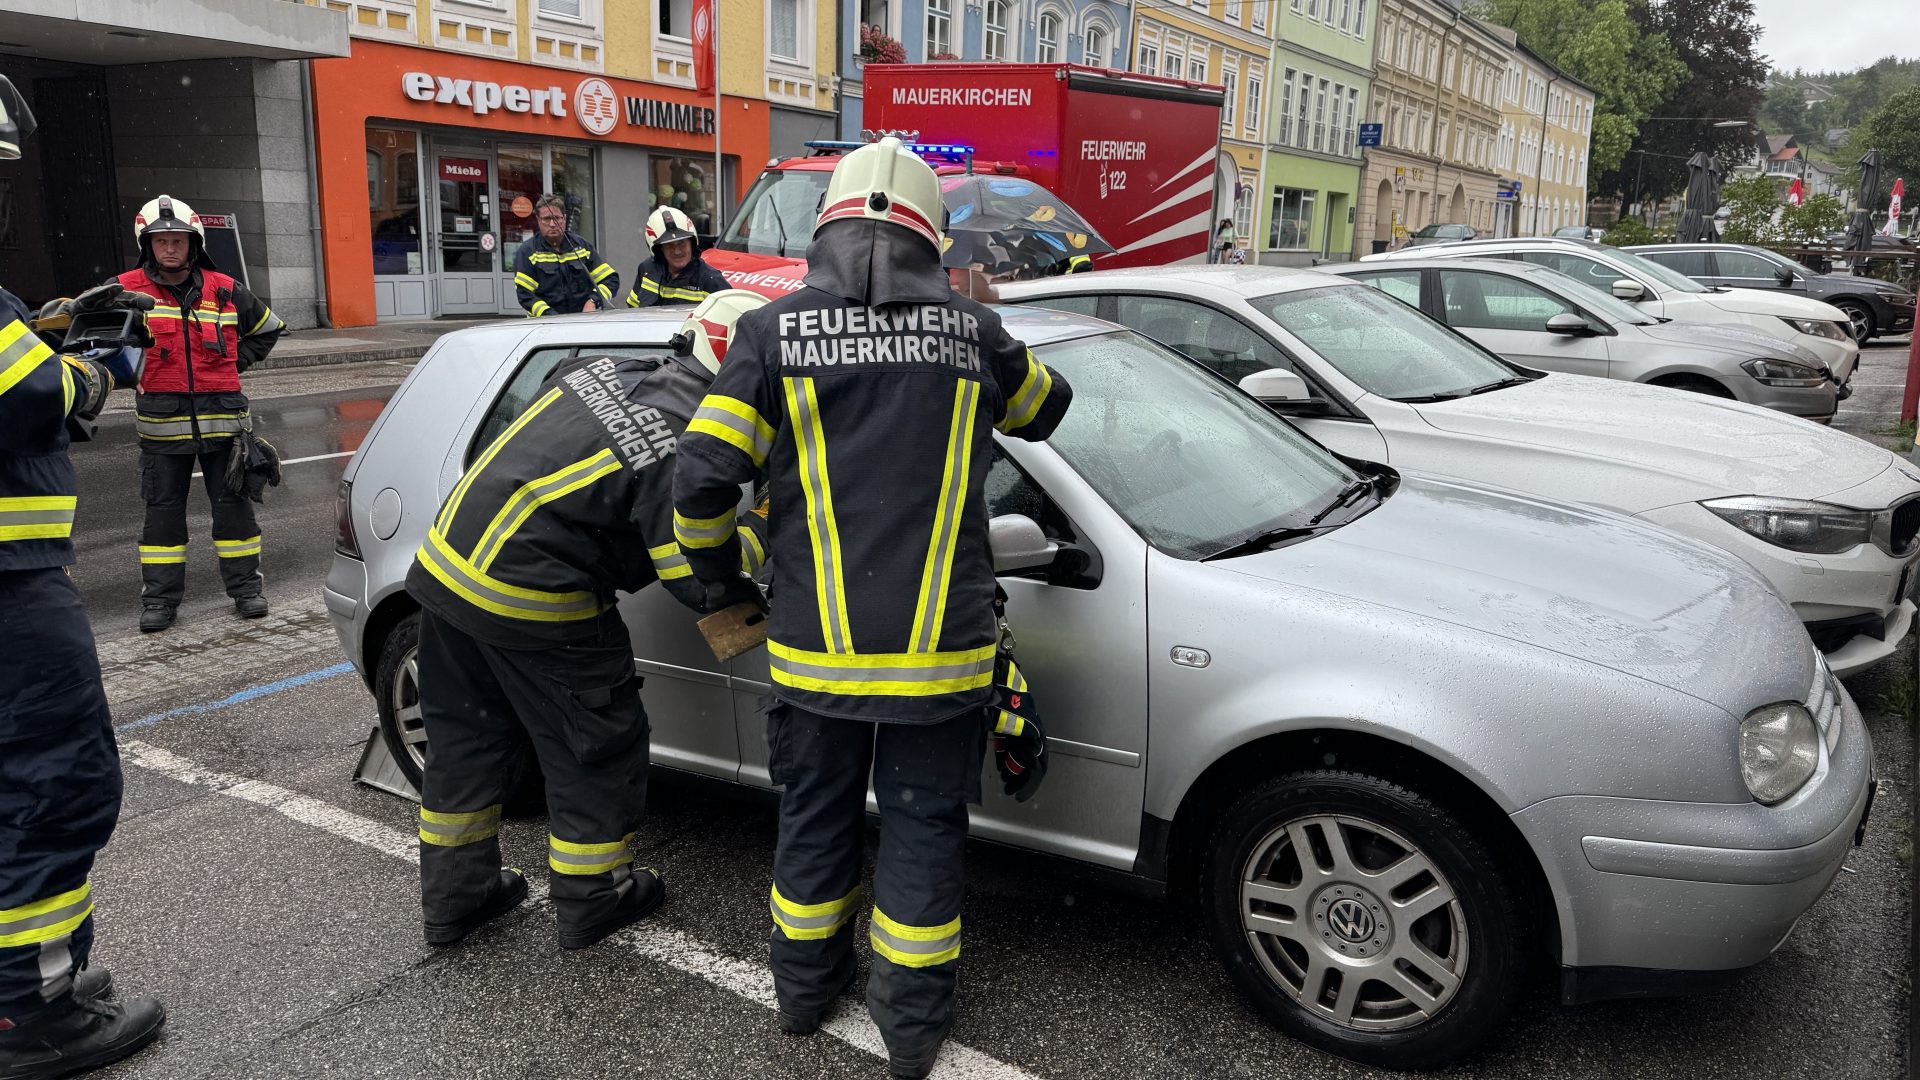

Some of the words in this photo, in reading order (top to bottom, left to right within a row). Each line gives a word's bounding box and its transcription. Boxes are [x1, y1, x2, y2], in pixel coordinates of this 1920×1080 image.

[402, 72, 566, 117] expert
[624, 96, 715, 135] WIMMER
[892, 87, 1032, 106] MAUERKIRCHEN
[1081, 140, 1147, 161] FEUERWEHR
[445, 165, 481, 176] Miele
[1109, 170, 1127, 190] 122
[201, 217, 225, 225] SPAR
[721, 270, 808, 291] ERWEHR
[779, 305, 980, 342] FEUERWEHR
[780, 335, 981, 373] MAUERKIRCHEN
[562, 367, 657, 471] MAUERKIRCHEN
